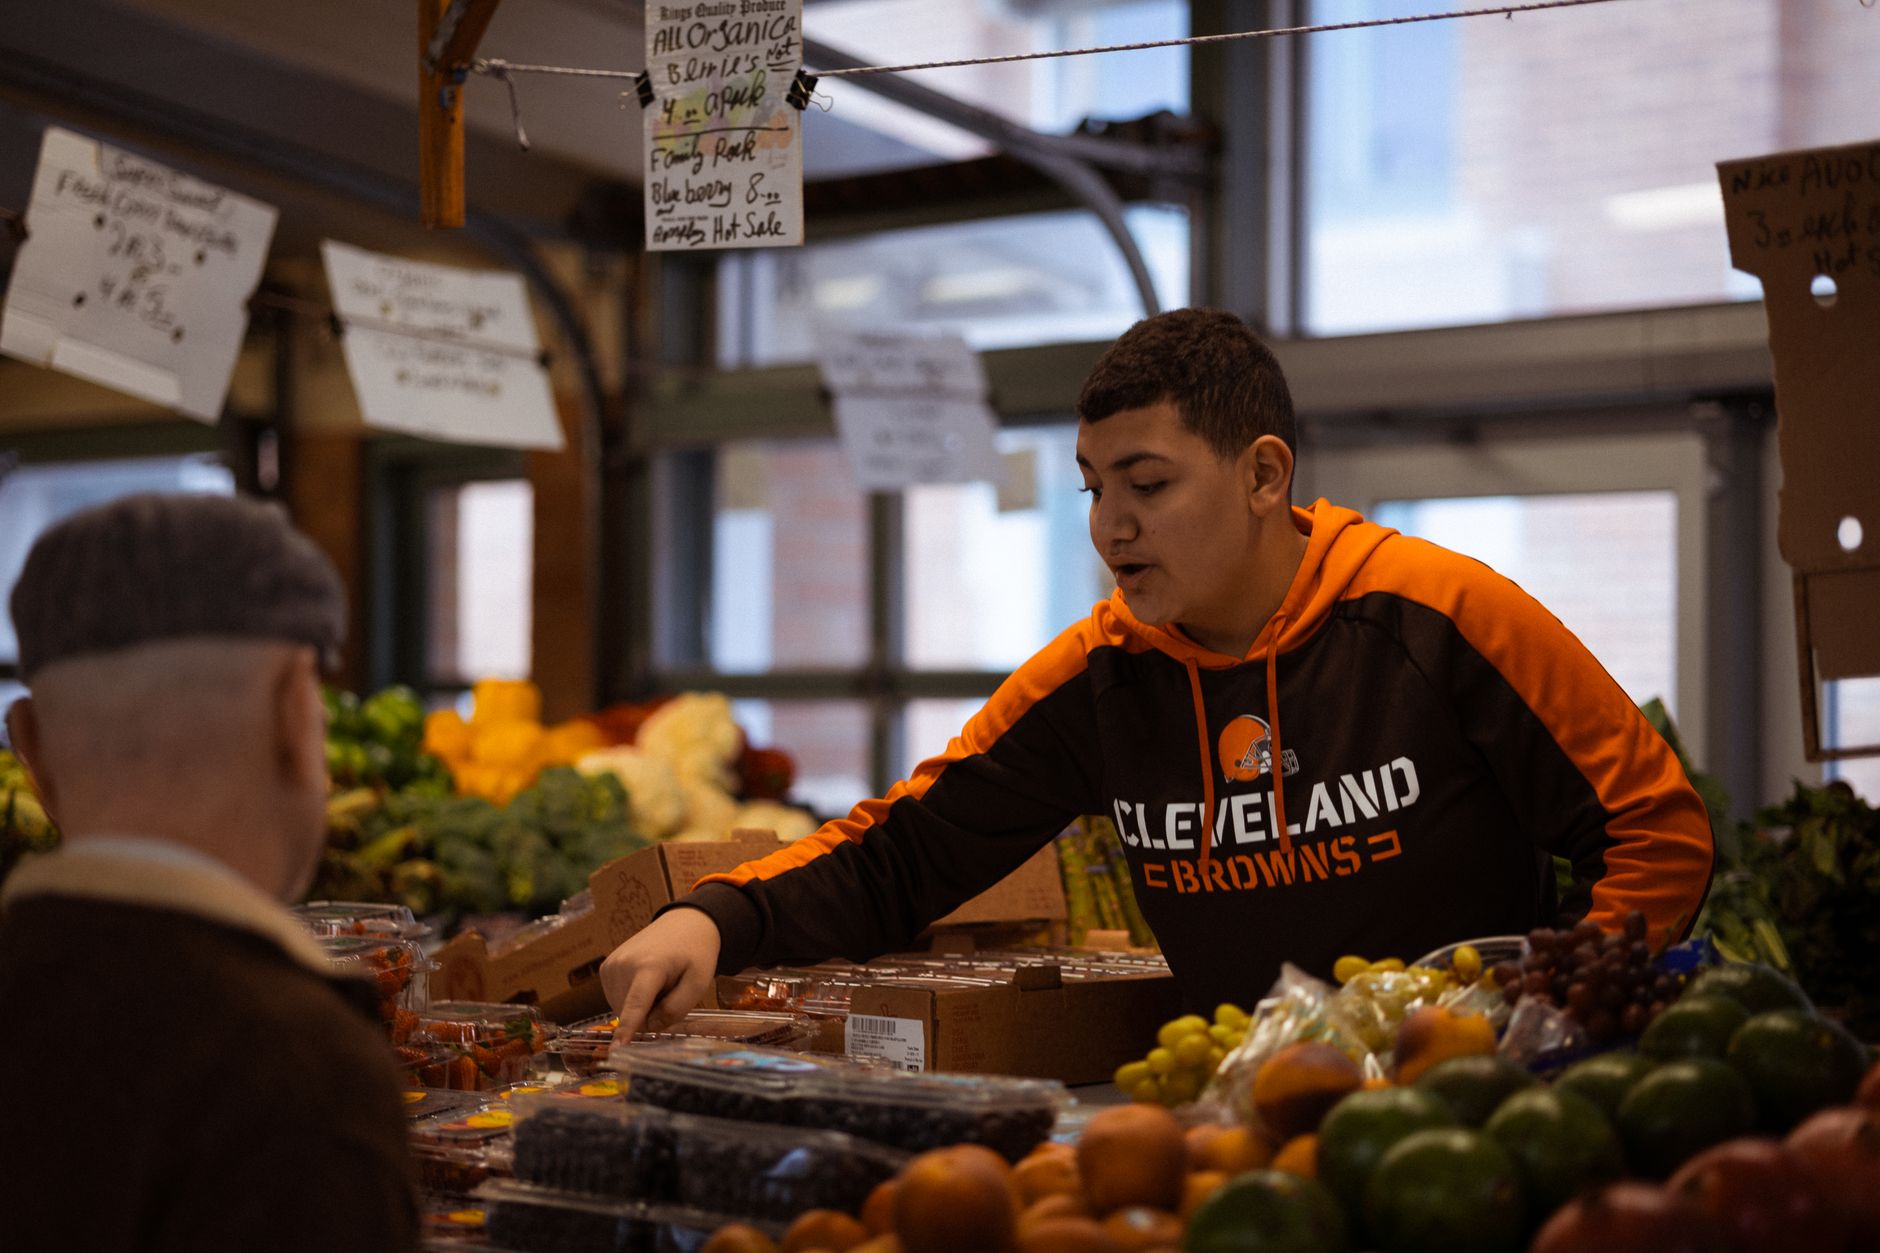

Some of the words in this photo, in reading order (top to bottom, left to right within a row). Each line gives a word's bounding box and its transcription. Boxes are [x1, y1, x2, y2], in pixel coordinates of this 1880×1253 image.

[695, 3, 736, 19] Quality
[740, 0, 786, 17] Produce
[713, 212, 741, 243] Hot
[743, 211, 787, 238] Sale
[1114, 756, 1420, 850] CLEVELAND
[1171, 835, 1362, 893] BROWNS
